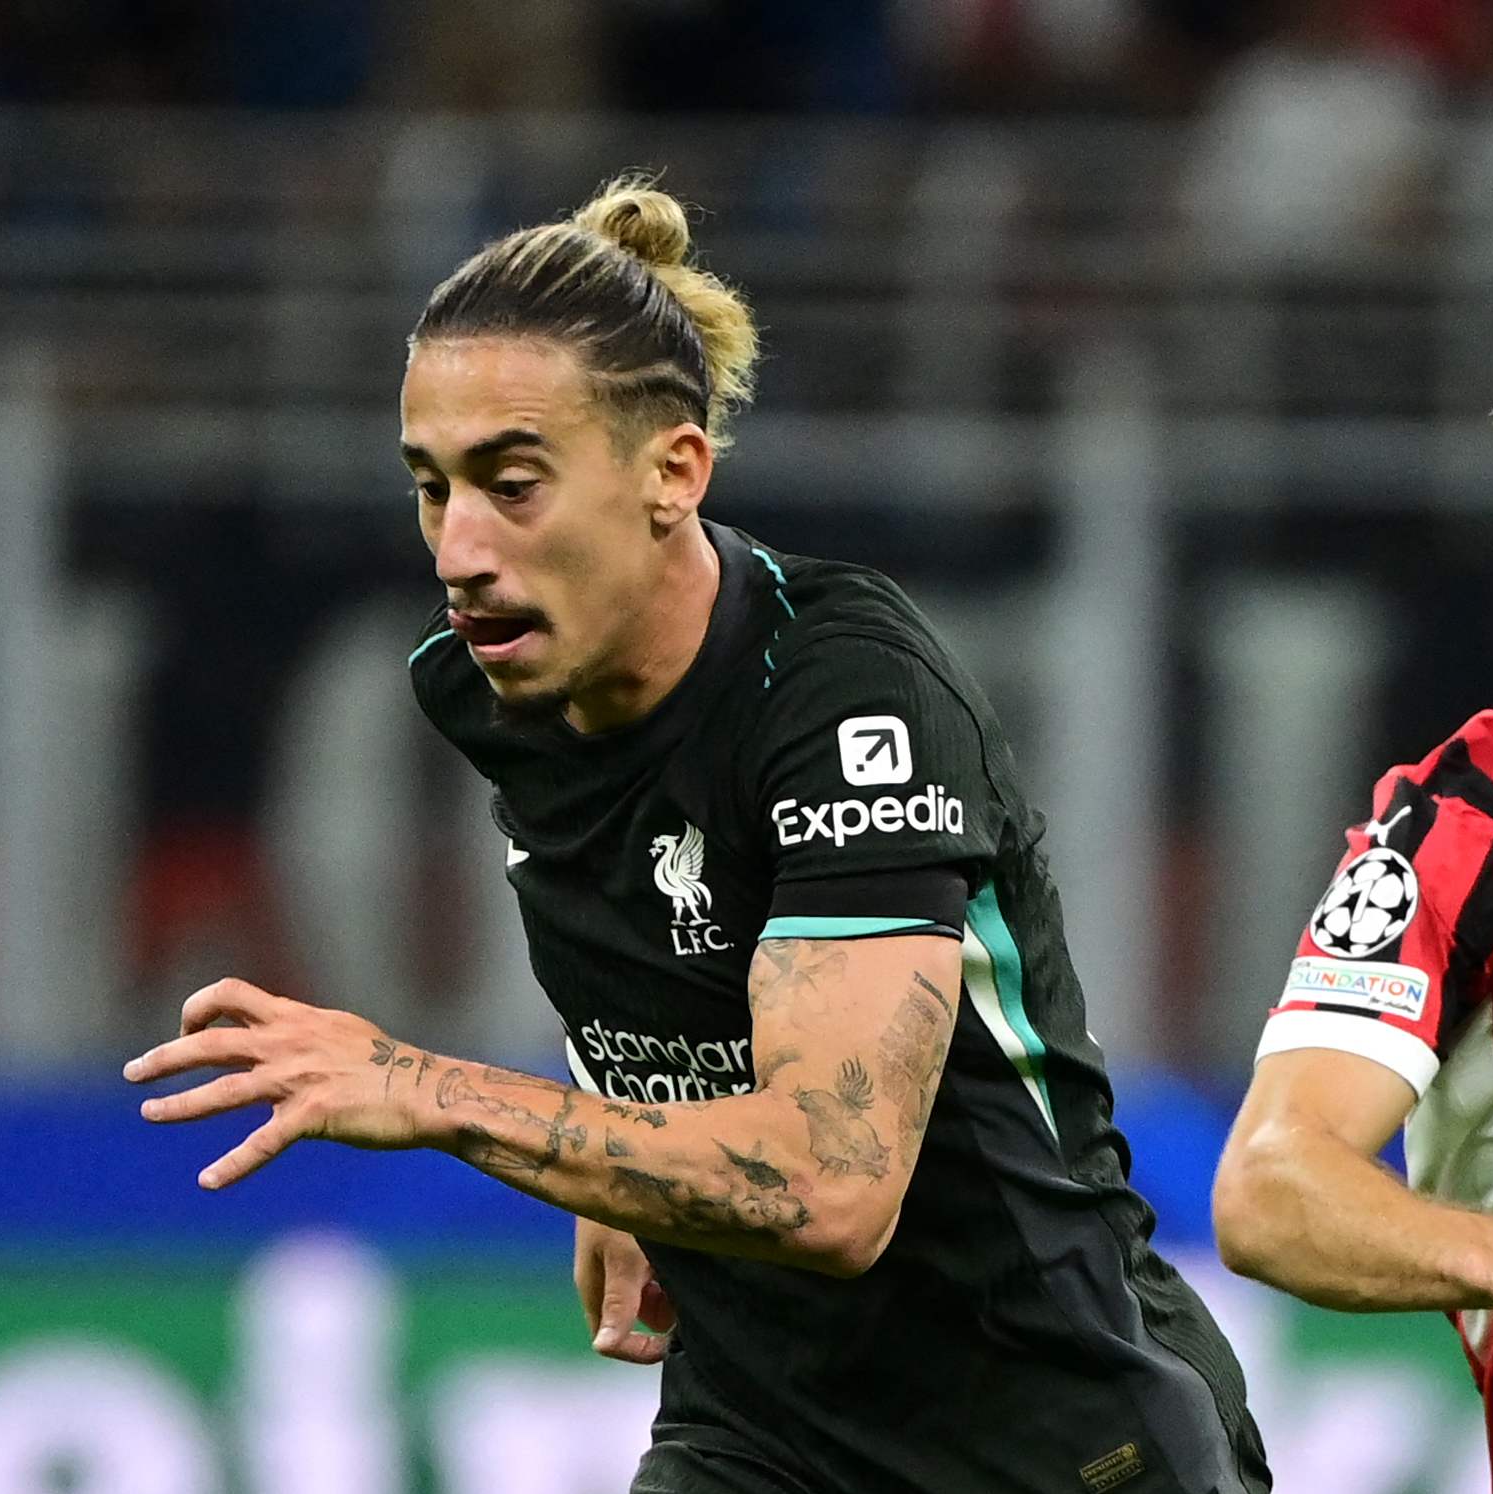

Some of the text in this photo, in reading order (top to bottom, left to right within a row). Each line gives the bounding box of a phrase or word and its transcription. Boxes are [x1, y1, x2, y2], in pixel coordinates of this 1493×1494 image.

[771, 785, 964, 847] Expedia
[670, 926, 735, 956] L.F.C.
[1288, 970, 1423, 1003] OUNDATION
[581, 1018, 749, 1073] standar
